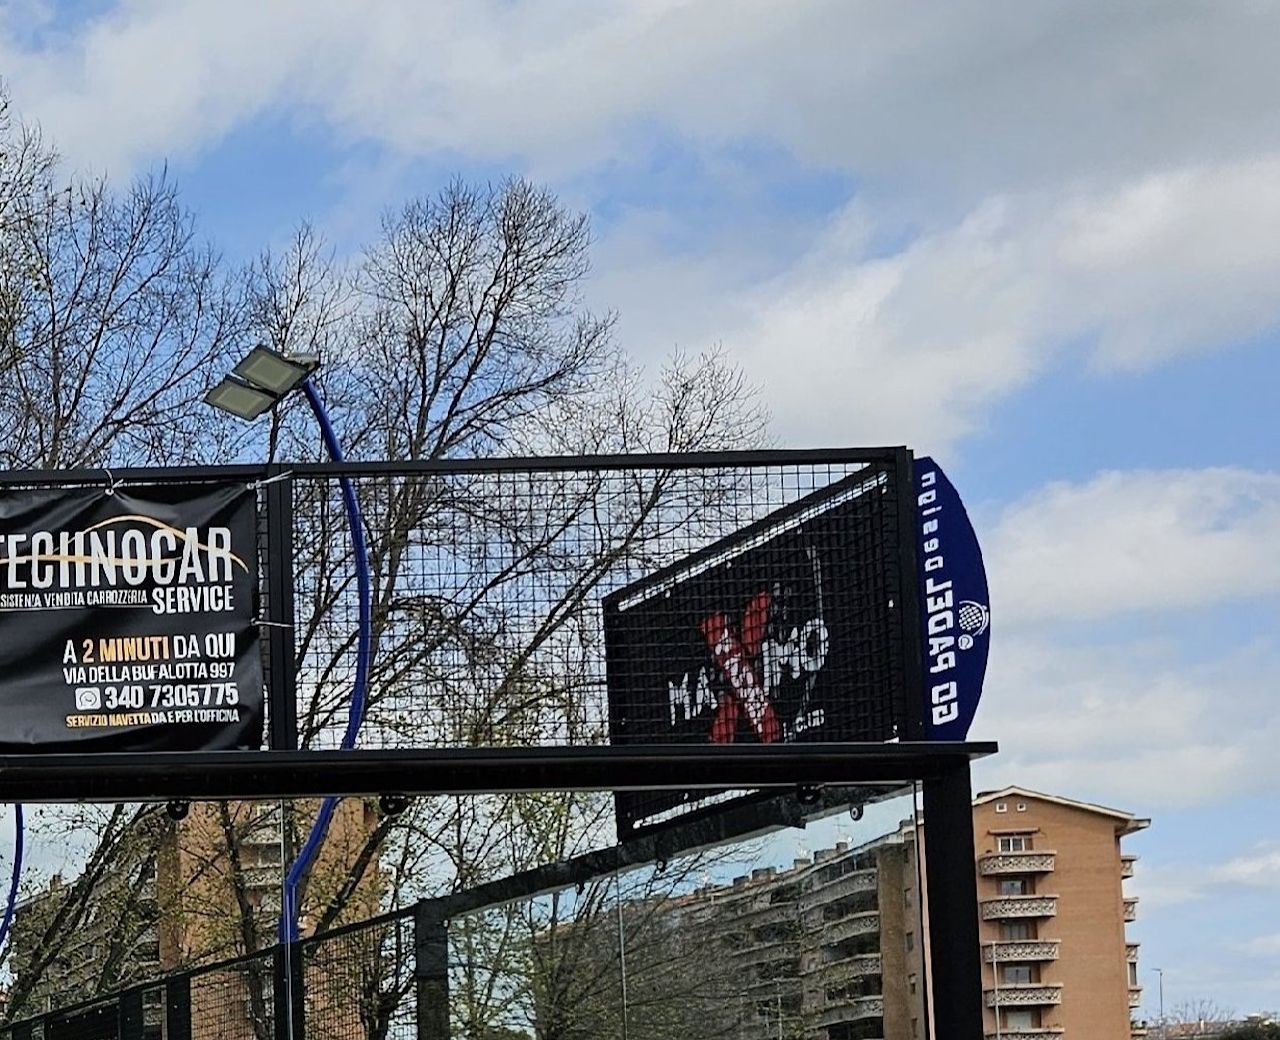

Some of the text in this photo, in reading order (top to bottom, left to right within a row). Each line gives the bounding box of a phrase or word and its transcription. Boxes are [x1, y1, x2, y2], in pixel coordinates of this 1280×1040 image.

[152, 585, 234, 615] SERVICE
[62, 632, 236, 664] A 2 MINUTI DA QUI
[63, 662, 236, 684] VIA DELLA BUFALOTTA 997
[104, 682, 240, 709] 340 7305775
[66, 714, 108, 728] SERVIZIO
[109, 712, 151, 727] NAVETTA
[151, 711, 168, 724] DA
[175, 710, 194, 723] PER
